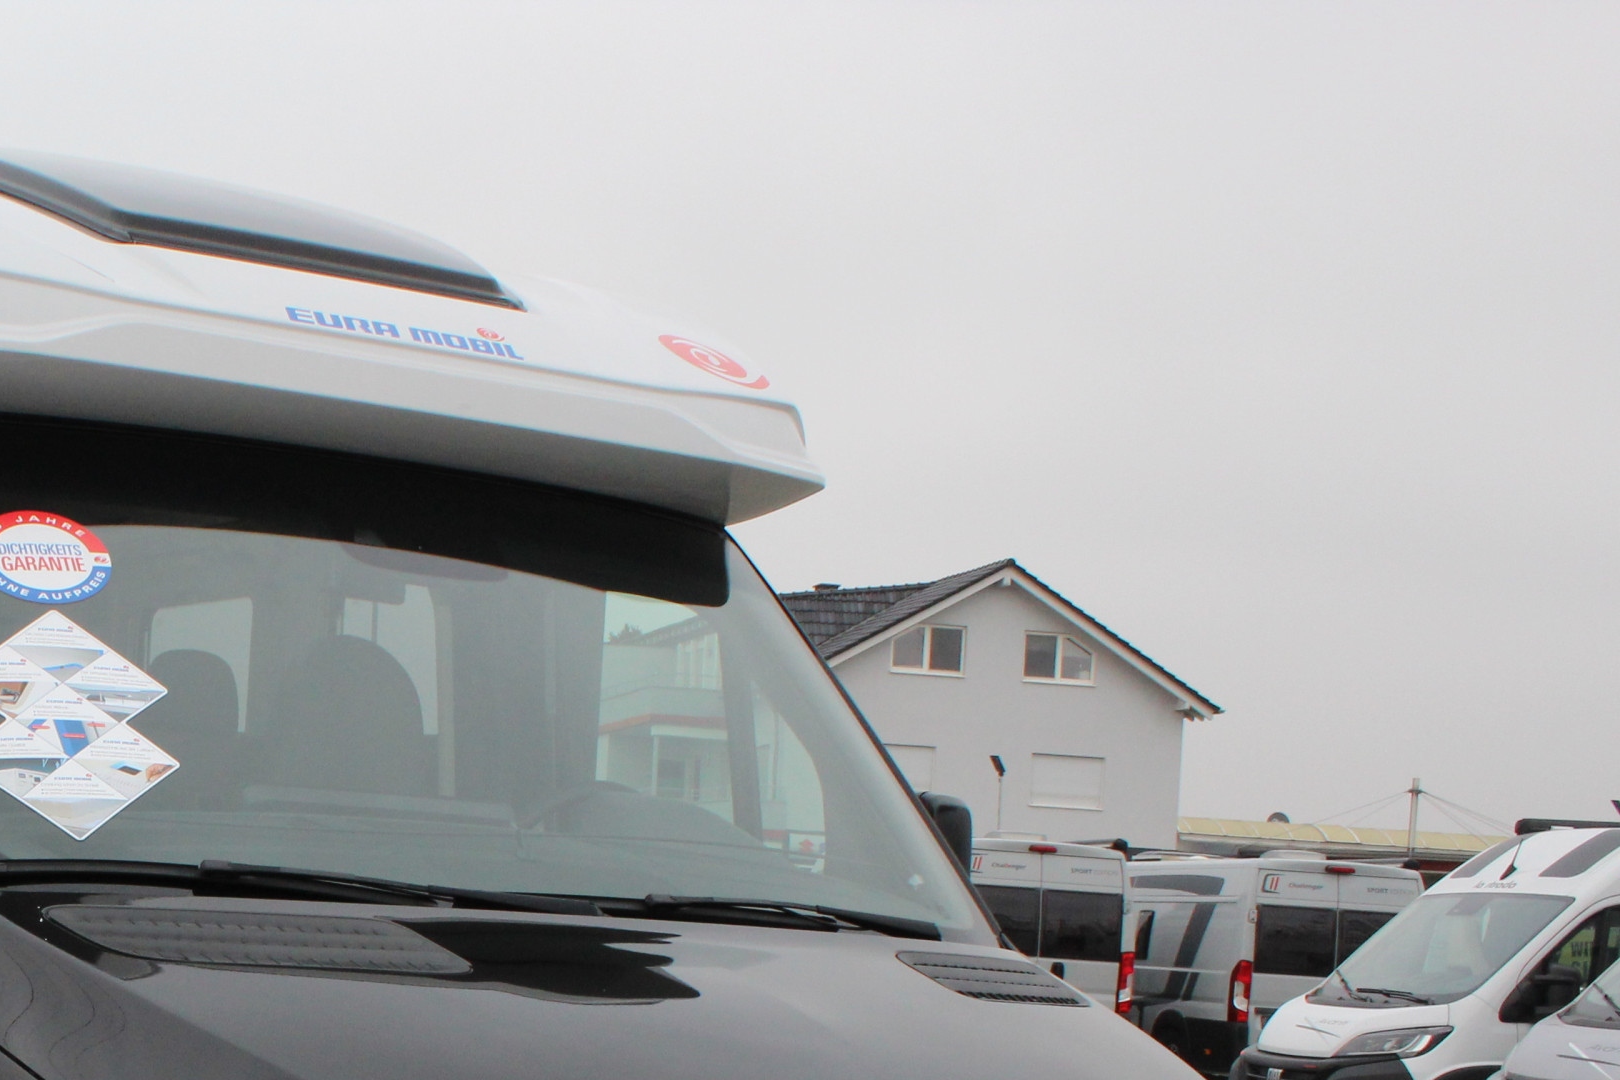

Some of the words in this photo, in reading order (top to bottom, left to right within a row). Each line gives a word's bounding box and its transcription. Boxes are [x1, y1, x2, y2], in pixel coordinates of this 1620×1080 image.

[285, 306, 400, 338] EURA
[408, 326, 524, 361] MOBIL
[15, 515, 86, 537] JAHRE
[1, 556, 87, 572] GARANTIE
[37, 571, 106, 600] AUFPREIS
